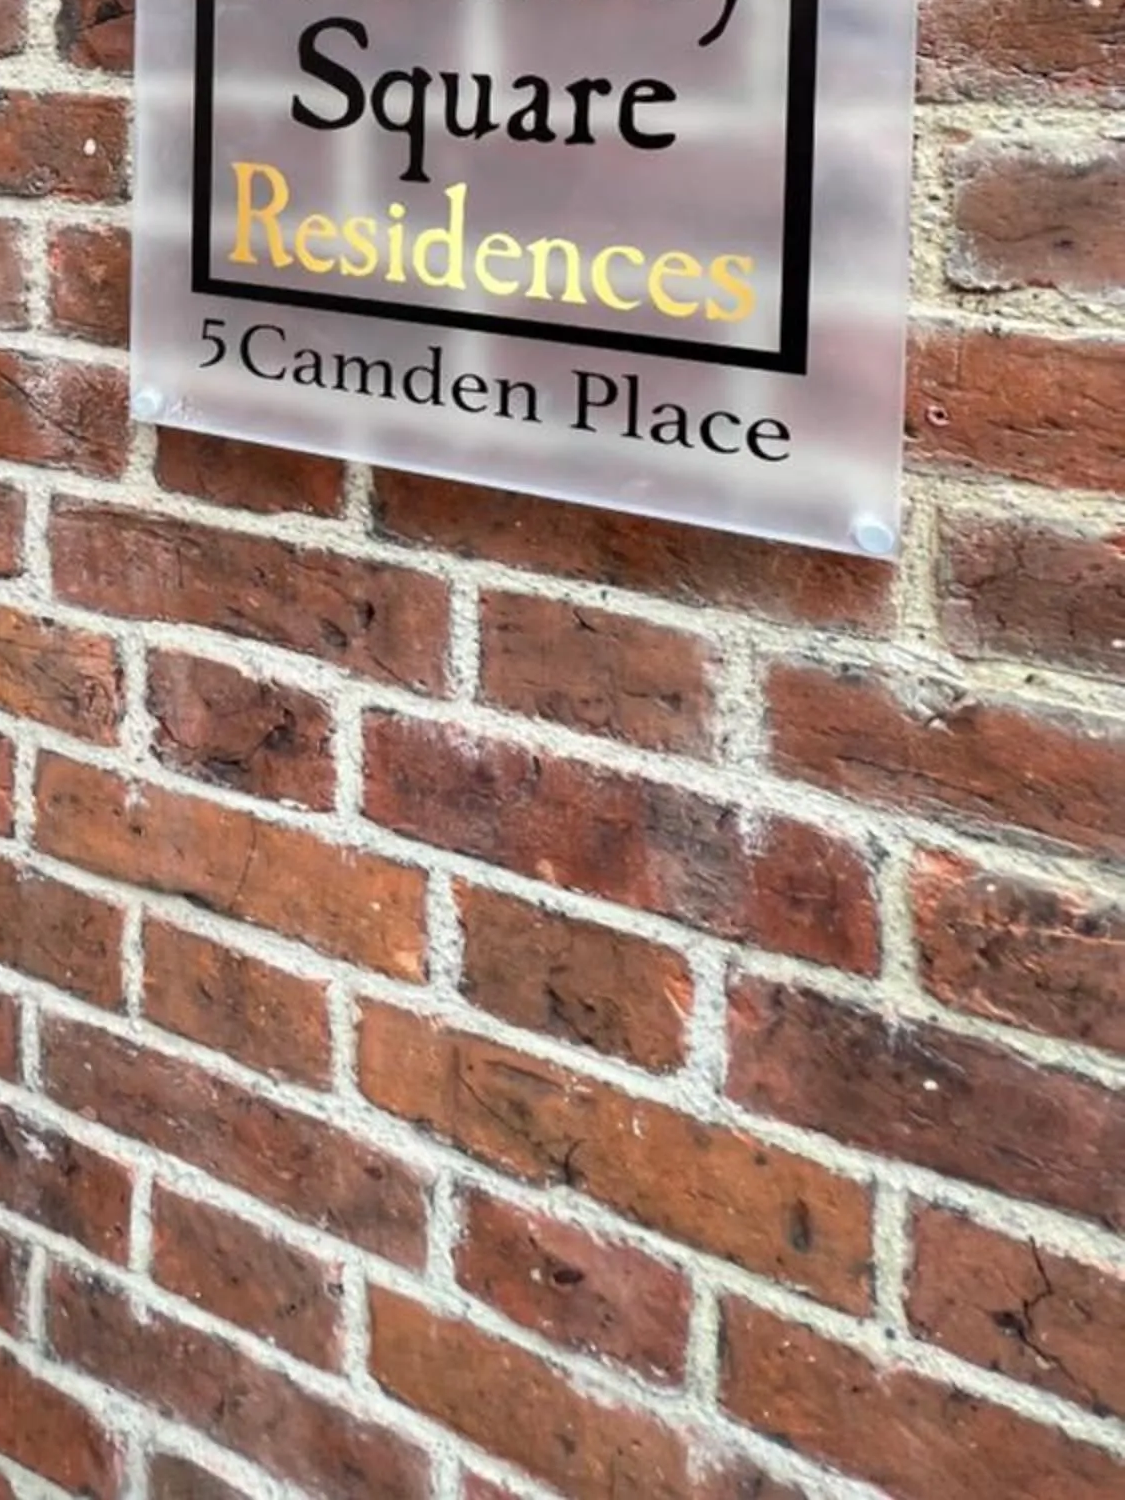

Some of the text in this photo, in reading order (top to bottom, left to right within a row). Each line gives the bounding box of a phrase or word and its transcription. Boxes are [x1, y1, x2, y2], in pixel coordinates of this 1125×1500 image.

[290, 16, 677, 184] Square
[228, 161, 756, 324] Residences
[199, 318, 791, 463] 5 Camden Place
